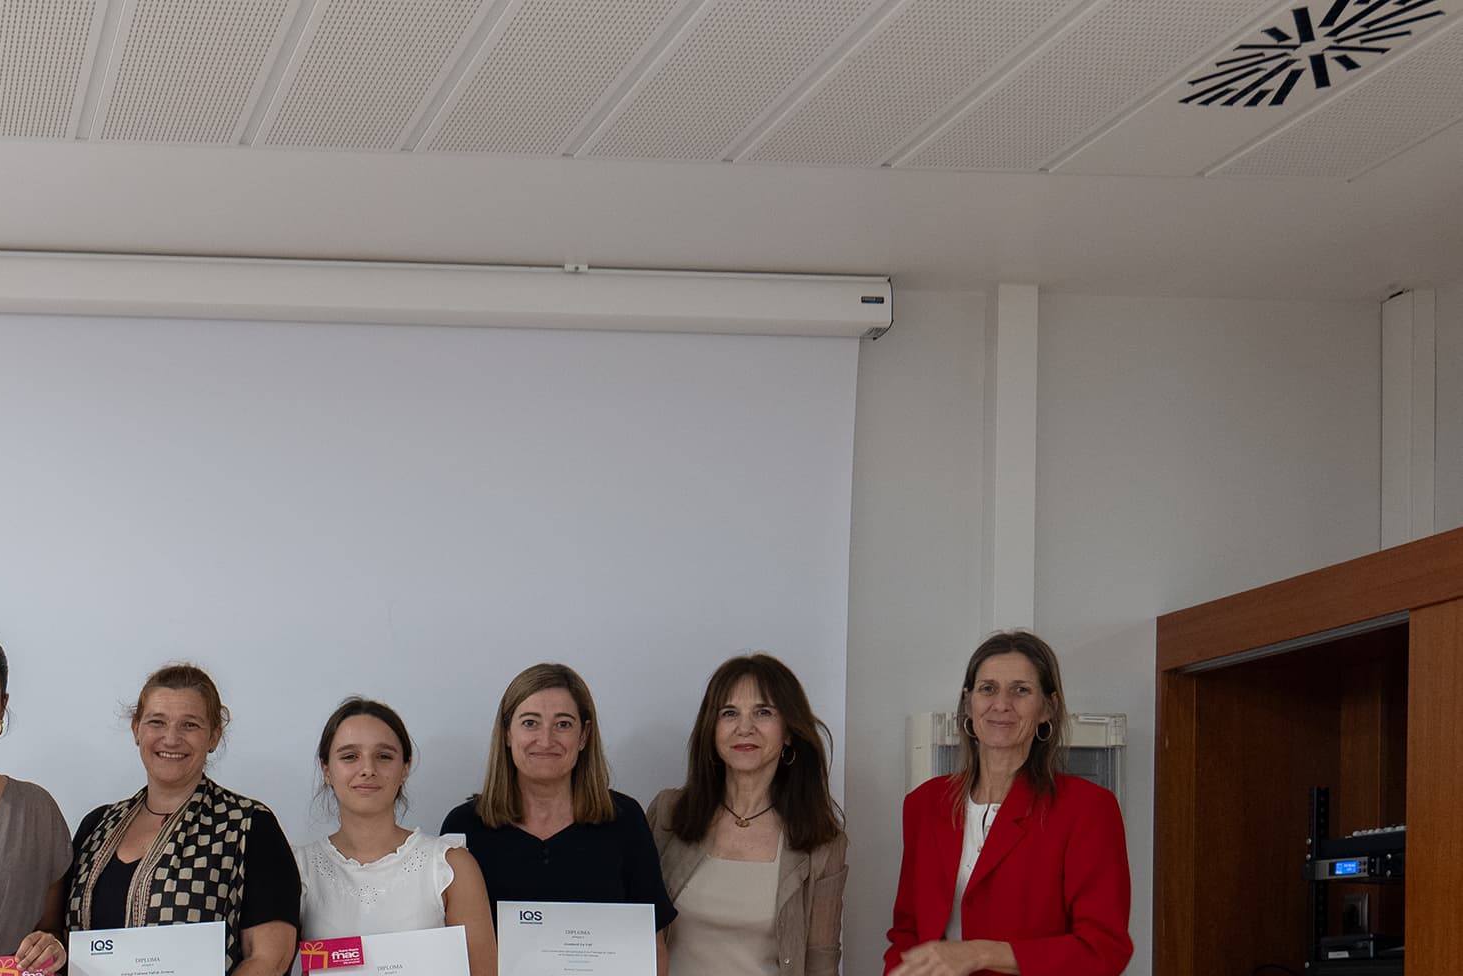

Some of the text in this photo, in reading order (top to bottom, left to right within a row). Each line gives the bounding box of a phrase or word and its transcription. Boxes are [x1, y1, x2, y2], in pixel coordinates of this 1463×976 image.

[519, 910, 543, 921] IQS
[90, 939, 114, 952] IQS
[332, 951, 359, 960] fnac
